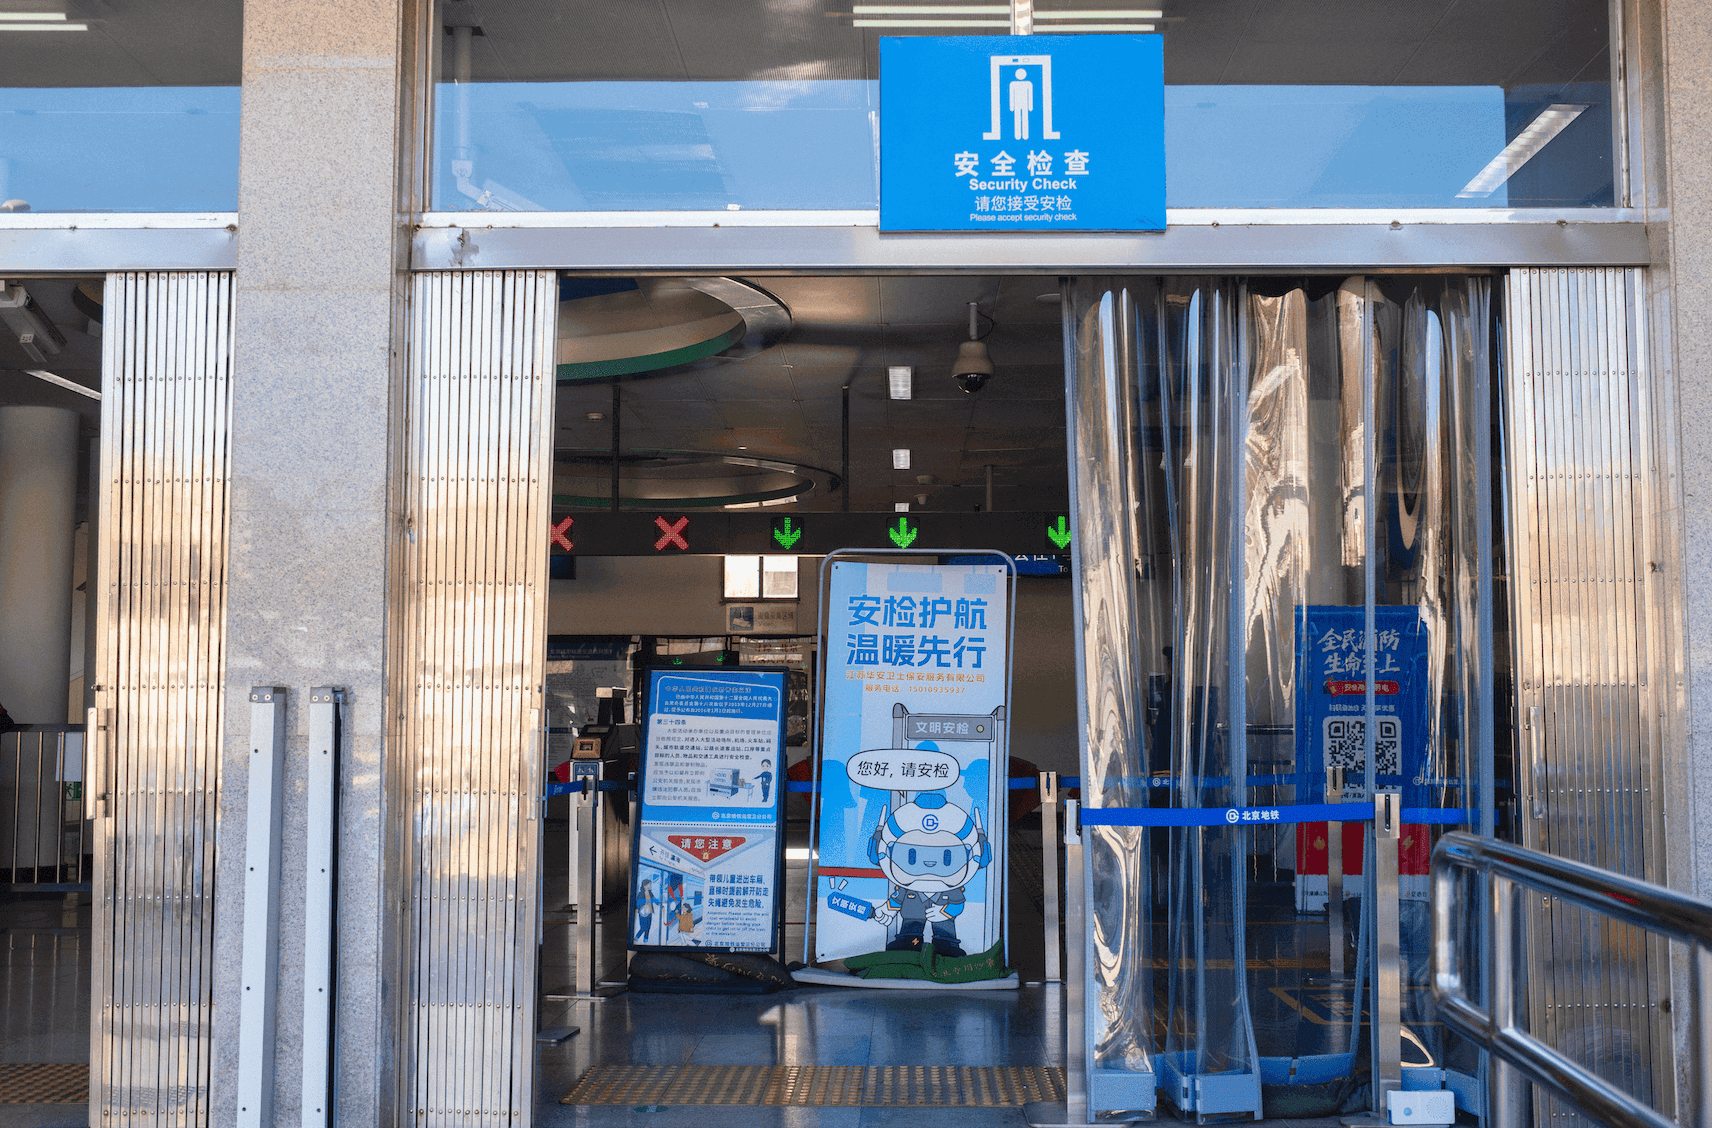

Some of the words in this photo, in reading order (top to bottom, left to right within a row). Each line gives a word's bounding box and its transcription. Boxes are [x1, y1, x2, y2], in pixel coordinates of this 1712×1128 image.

[954, 149, 1090, 177] 安全检查
[969, 177, 1029, 193] Security
[1032, 177, 1077, 190] Check
[974, 195, 1072, 212] 请您接受安检
[970, 213, 996, 222] Please
[997, 214, 1023, 223] accept
[1024, 213, 1053, 223] security
[1054, 213, 1077, 222] check
[847, 594, 988, 630] 安检护航
[846, 633, 987, 669] 温暖先行
[846, 670, 986, 683] 江苏华安卫士保安服务有限公司
[915, 721, 969, 735] 文明安检
[857, 761, 949, 779] 您好，请安检
[1241, 809, 1280, 821] 北京地铁
[680, 838, 733, 850] 请您注意
[708, 885, 769, 897] 直梯时提前解开防走
